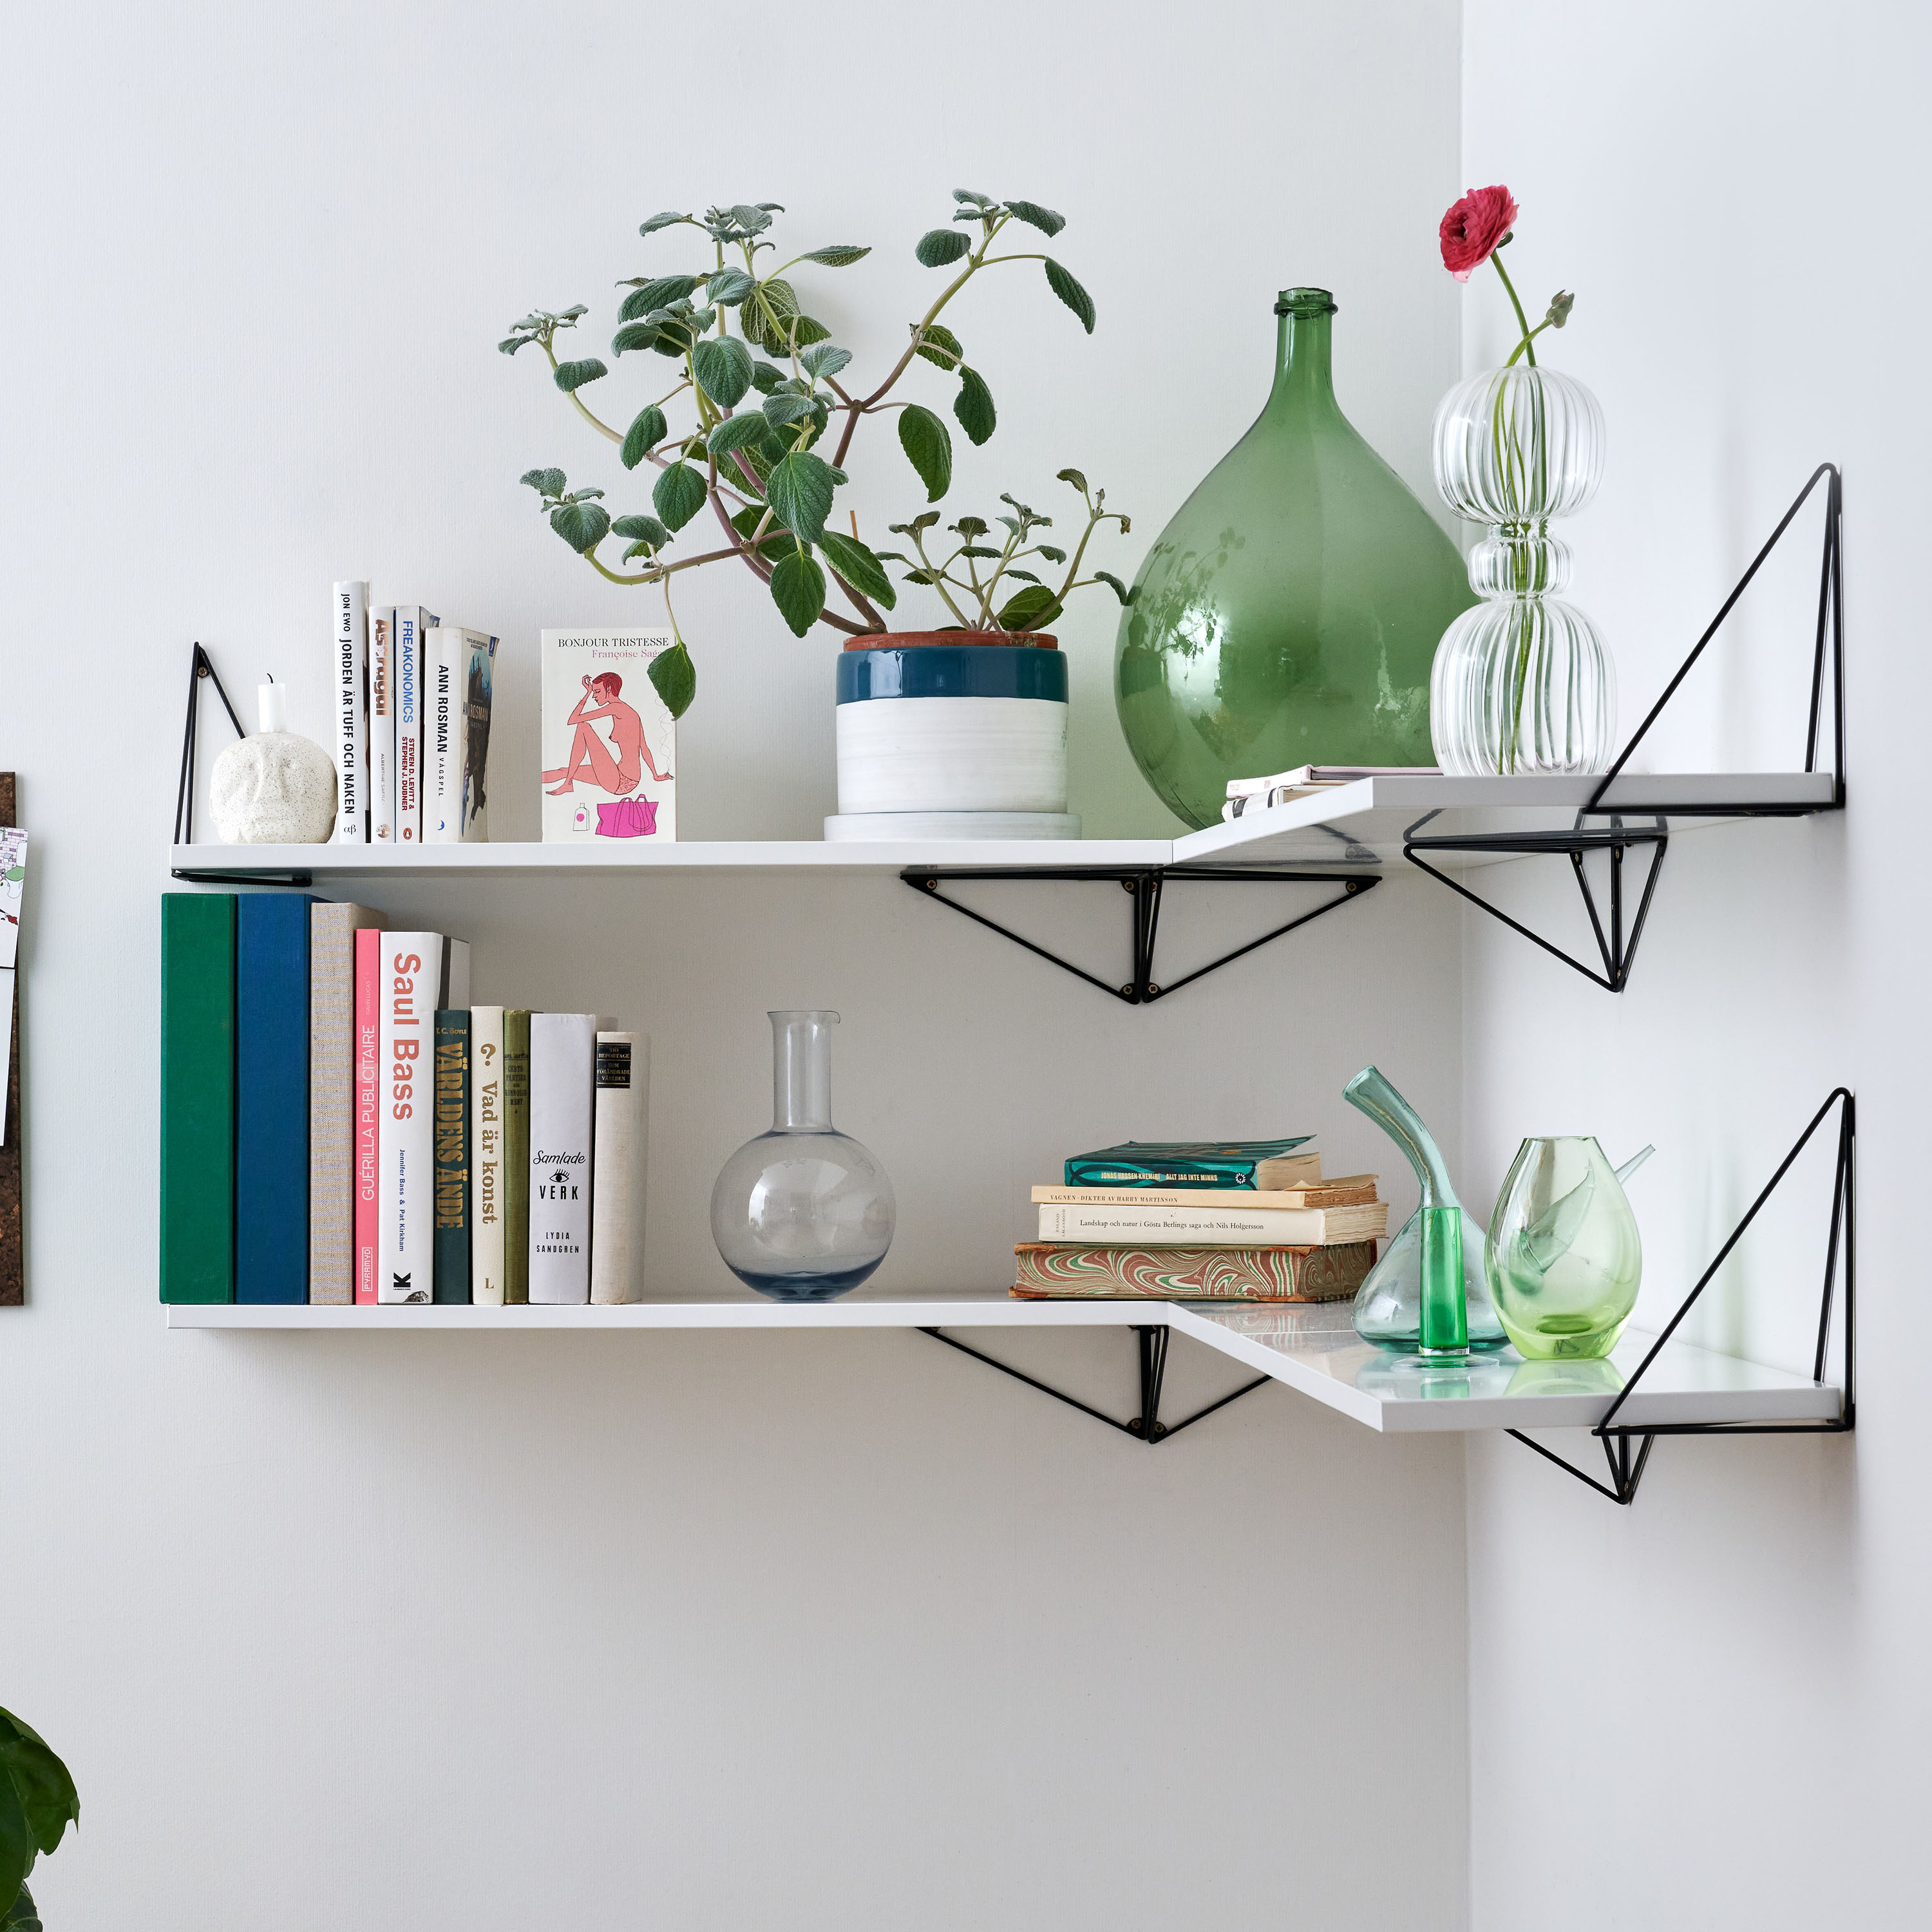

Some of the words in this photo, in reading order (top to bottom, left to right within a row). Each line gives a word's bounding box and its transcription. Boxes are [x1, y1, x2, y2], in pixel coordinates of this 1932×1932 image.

[341, 594, 350, 609] JON
[558, 638, 609, 647] BONJOUR
[611, 637, 669, 647] TRISTESSE
[592, 649, 638, 660] Françoise
[339, 638, 352, 685] JORDEN
[403, 621, 413, 723] FREAKONOMICS
[438, 665, 449, 693] ANN
[343, 690, 355, 705] ÄR
[343, 709, 353, 738] TUFF
[437, 697, 448, 752] ROSMAN
[343, 743, 354, 768] OCH
[344, 773, 355, 813] NAKEN
[393, 952, 421, 1025] Saul
[362, 1025, 375, 1122] PUBLICITAIRE
[393, 1039, 419, 1120] Bass
[436, 1041, 468, 1162] VÄRLDENS
[482, 1081, 498, 1123] Vad
[482, 1129, 498, 1154] är
[359, 1127, 374, 1200] GUÉRILLA
[533, 1150, 586, 1164] Samlade
[437, 1166, 468, 1228] ÄNDE
[482, 1160, 498, 1224] konst
[540, 1186, 578, 1200] VERK
[1080, 1220, 1108, 1228] Landskap
[1163, 1221, 1187, 1229] Berlings
[1231, 1222, 1264, 1231] Holgersson
[536, 1245, 579, 1253] SANDGREN
[484, 1278, 494, 1289] L
